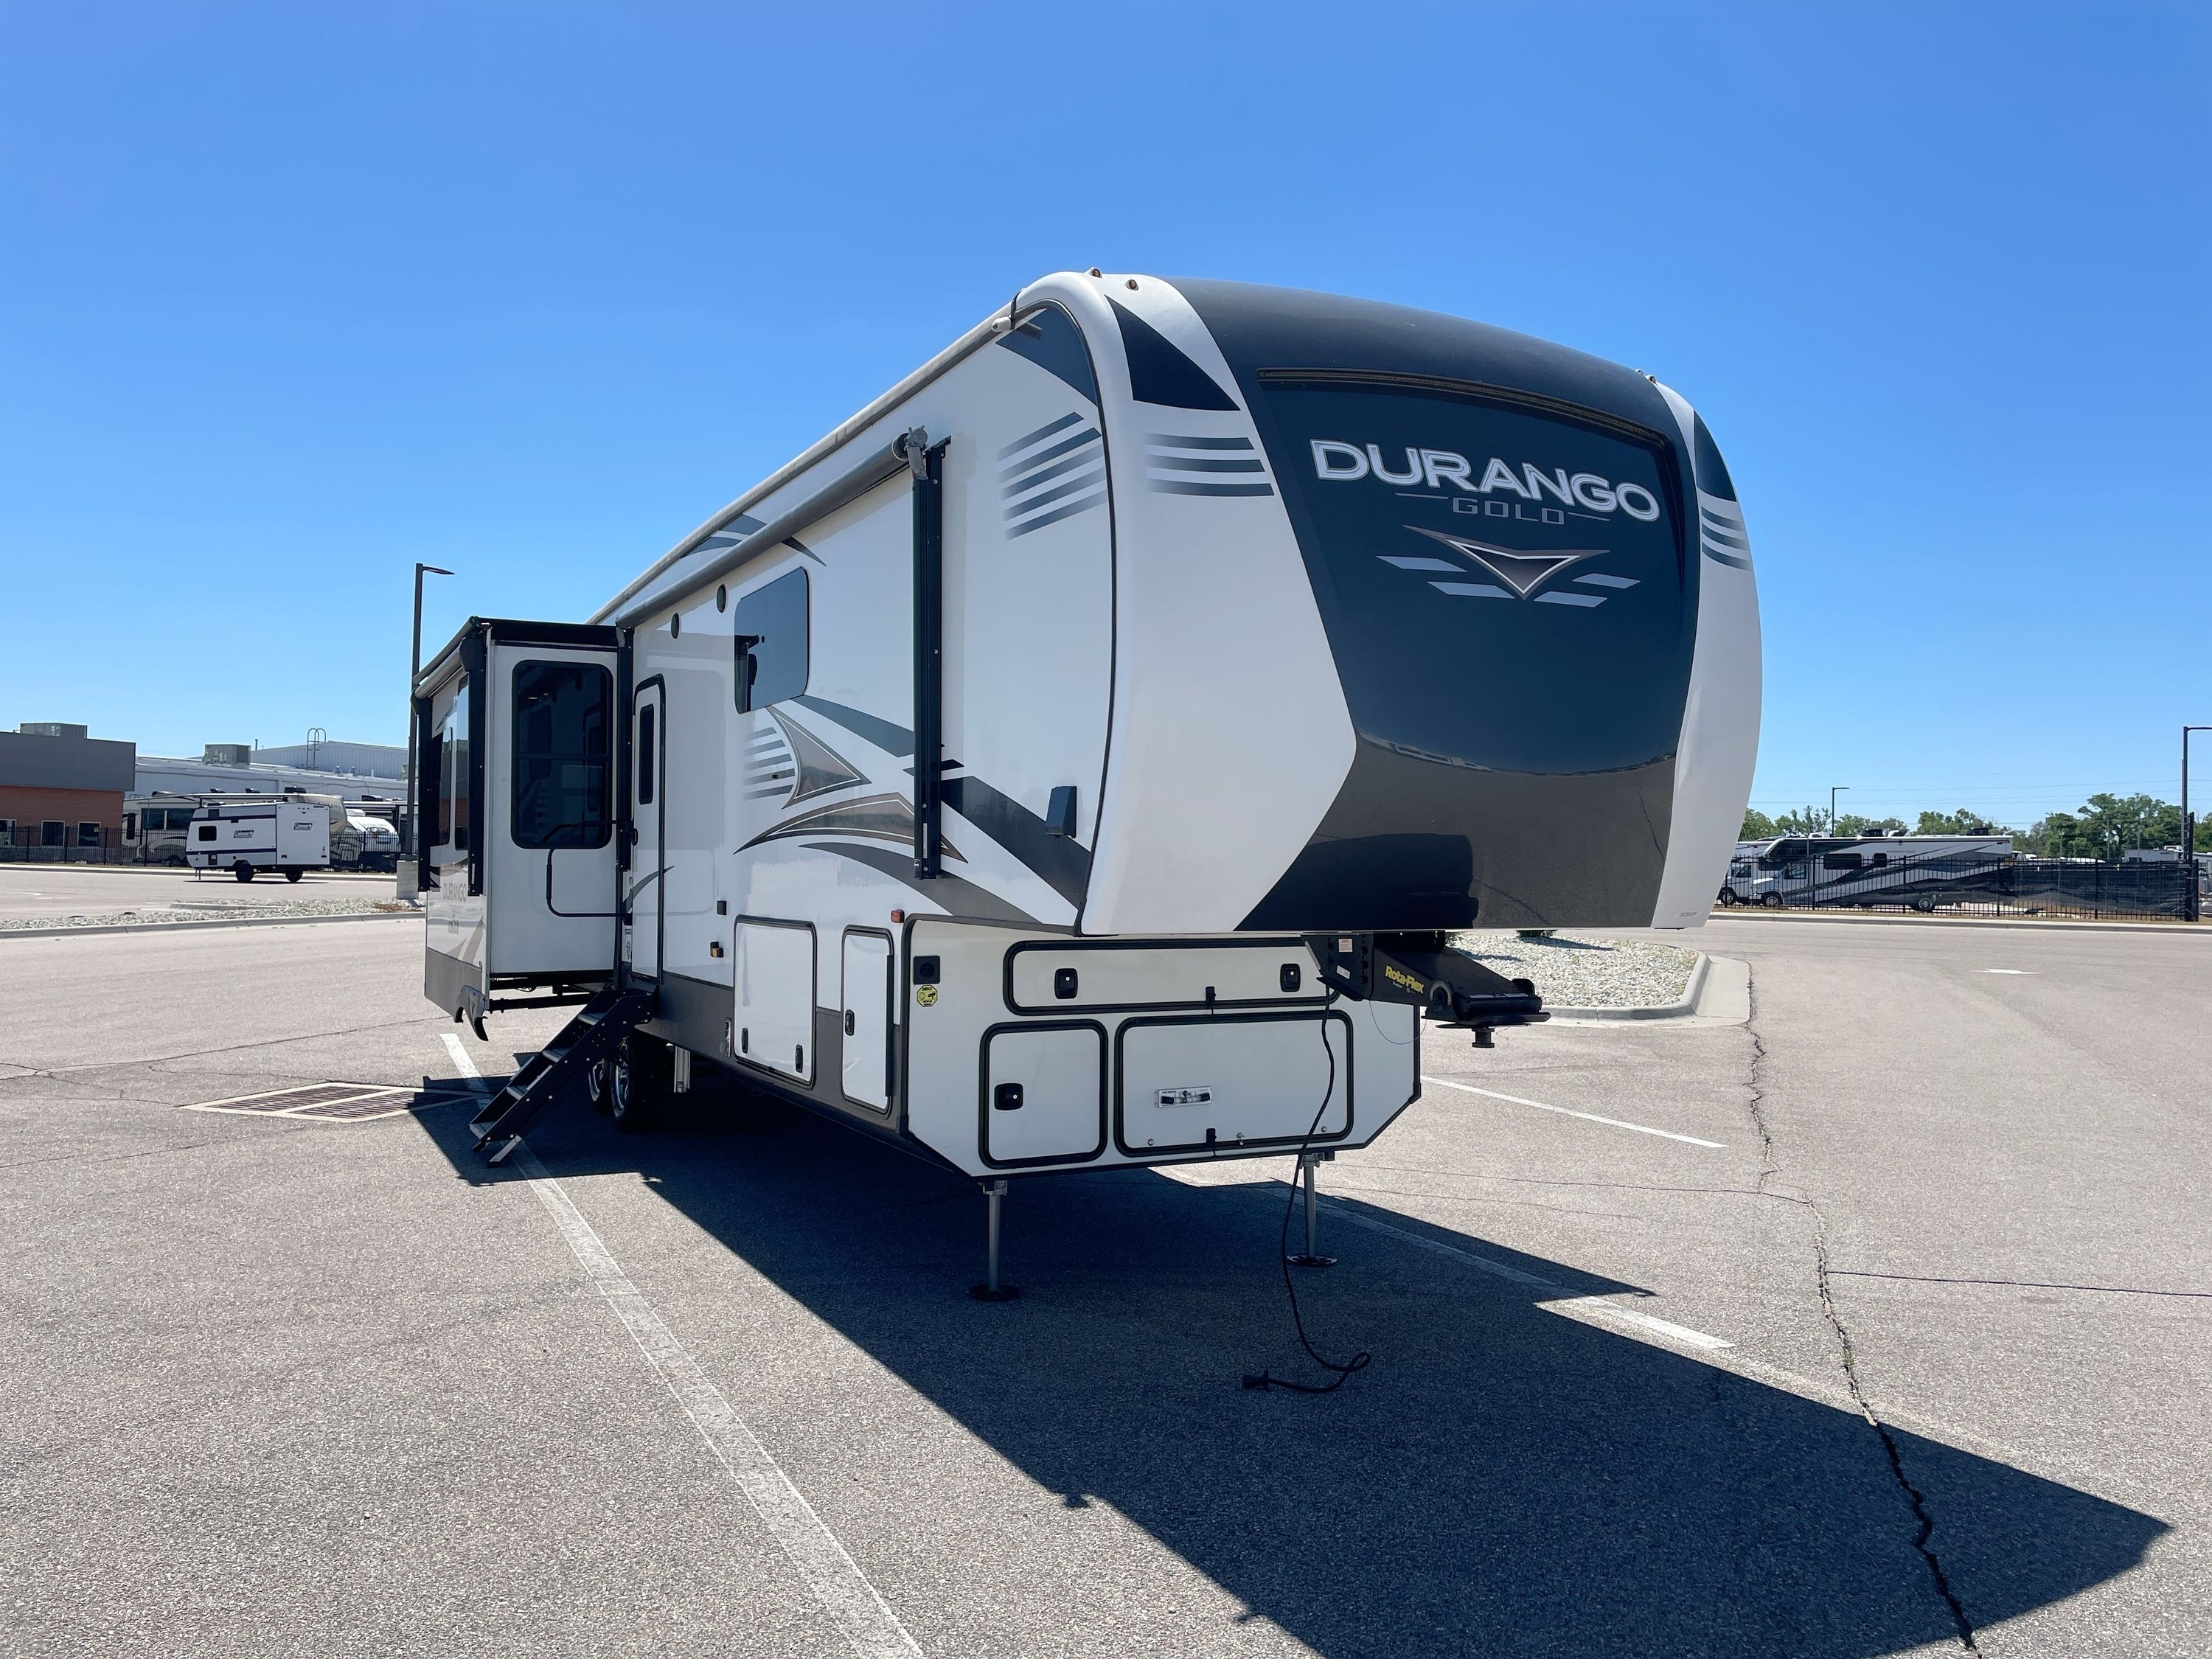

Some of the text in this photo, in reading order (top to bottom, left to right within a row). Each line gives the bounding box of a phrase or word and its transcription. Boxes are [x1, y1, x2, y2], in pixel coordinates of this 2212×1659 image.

[1310, 439, 1660, 522] DURANGO
[1453, 497, 1565, 525] GOLD
[443, 883, 467, 902] DURANGO
